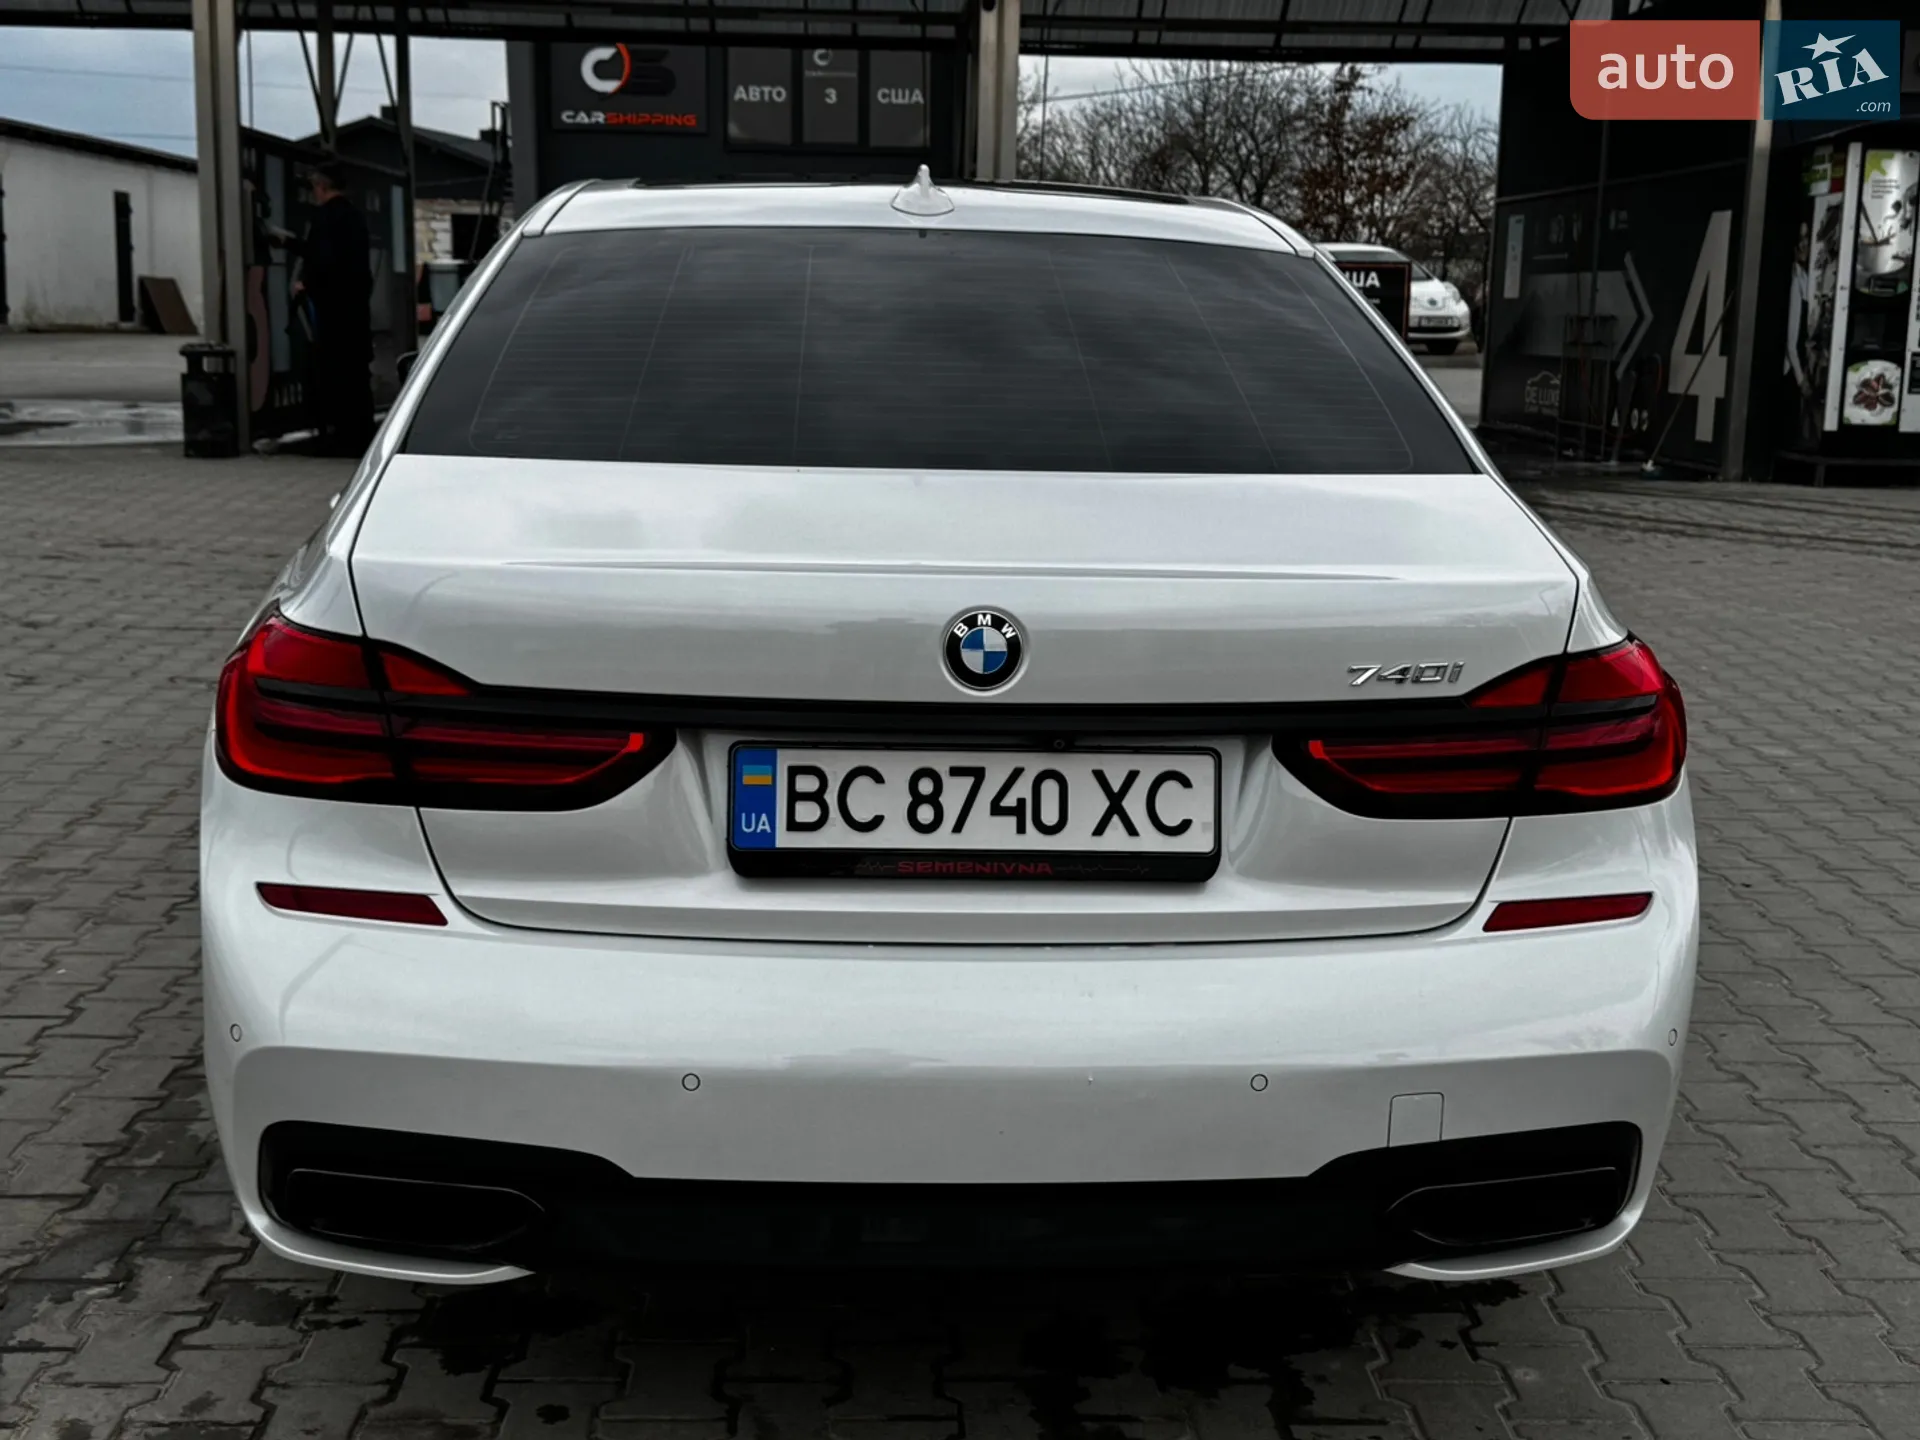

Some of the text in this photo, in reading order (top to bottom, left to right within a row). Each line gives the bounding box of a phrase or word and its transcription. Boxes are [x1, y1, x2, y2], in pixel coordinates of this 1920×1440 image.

[733, 85, 787, 102] АВТО
[876, 88, 925, 105] США
[1667, 208, 1734, 443] 4
[953, 613, 1017, 639] BMW
[1347, 661, 1465, 686] 740i
[785, 765, 1194, 838] BC 8740 XC
[741, 813, 771, 834] UA
